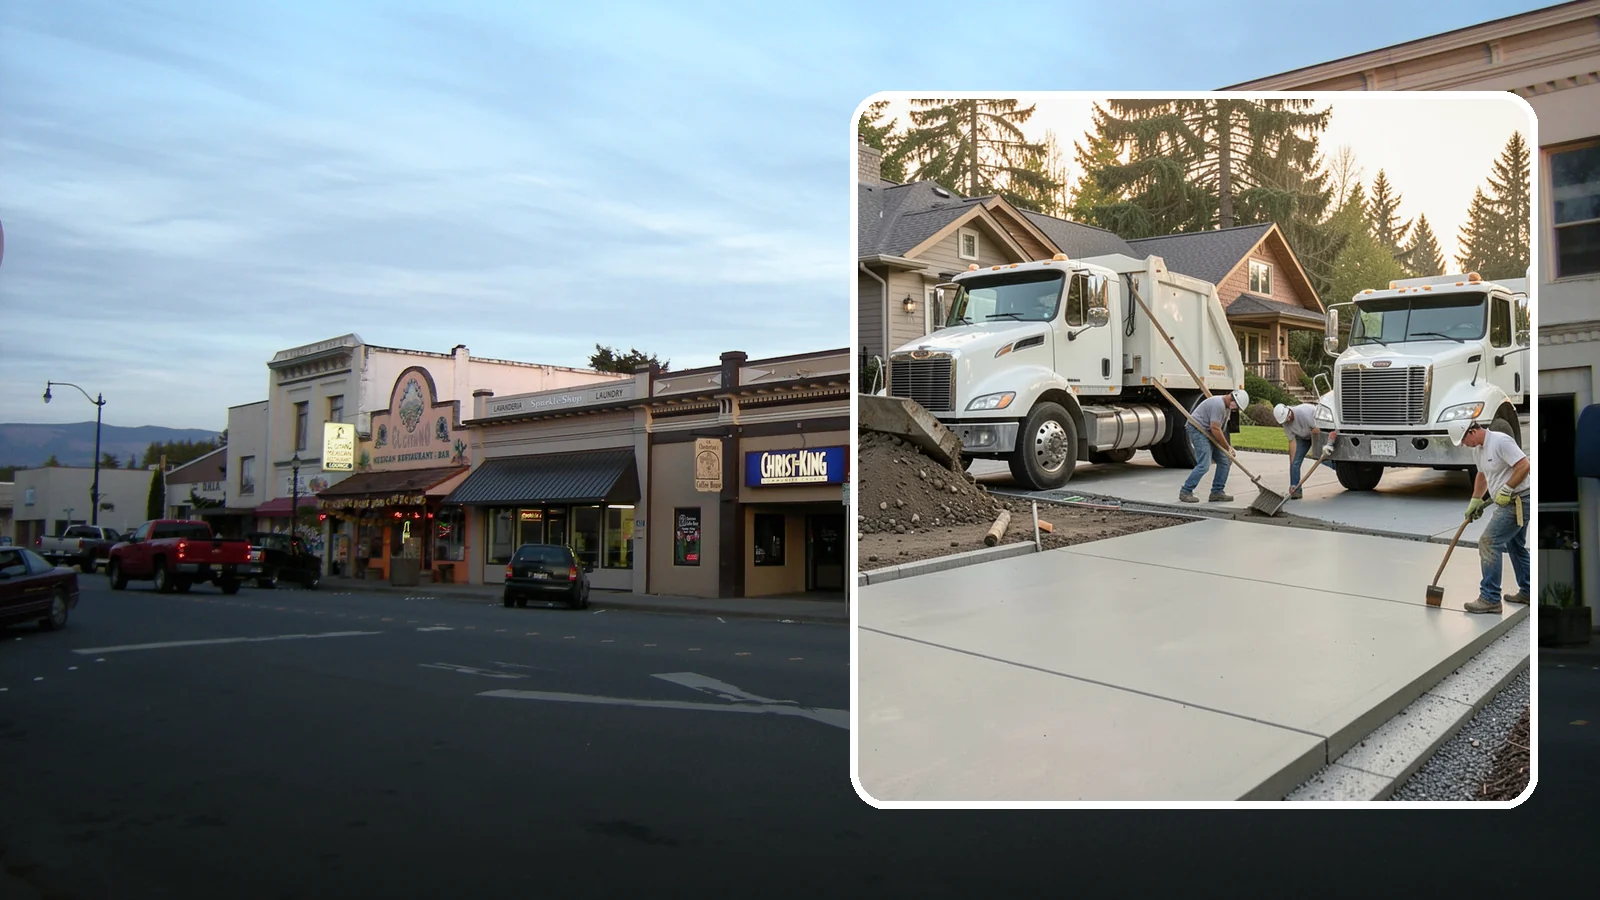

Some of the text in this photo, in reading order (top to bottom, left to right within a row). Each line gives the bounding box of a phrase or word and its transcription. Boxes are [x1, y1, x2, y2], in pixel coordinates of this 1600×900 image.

[595, 388, 624, 400] LAUNDRY
[493, 402, 523, 413] LAVANDERIA
[530, 394, 583, 409] Sparkle Shop
[373, 450, 450, 464] MEXICAN RESTAURANT BAR
[761, 452, 797, 478] CHRIST
[799, 450, 827, 476] KING
[696, 480, 709, 489] Coffee
